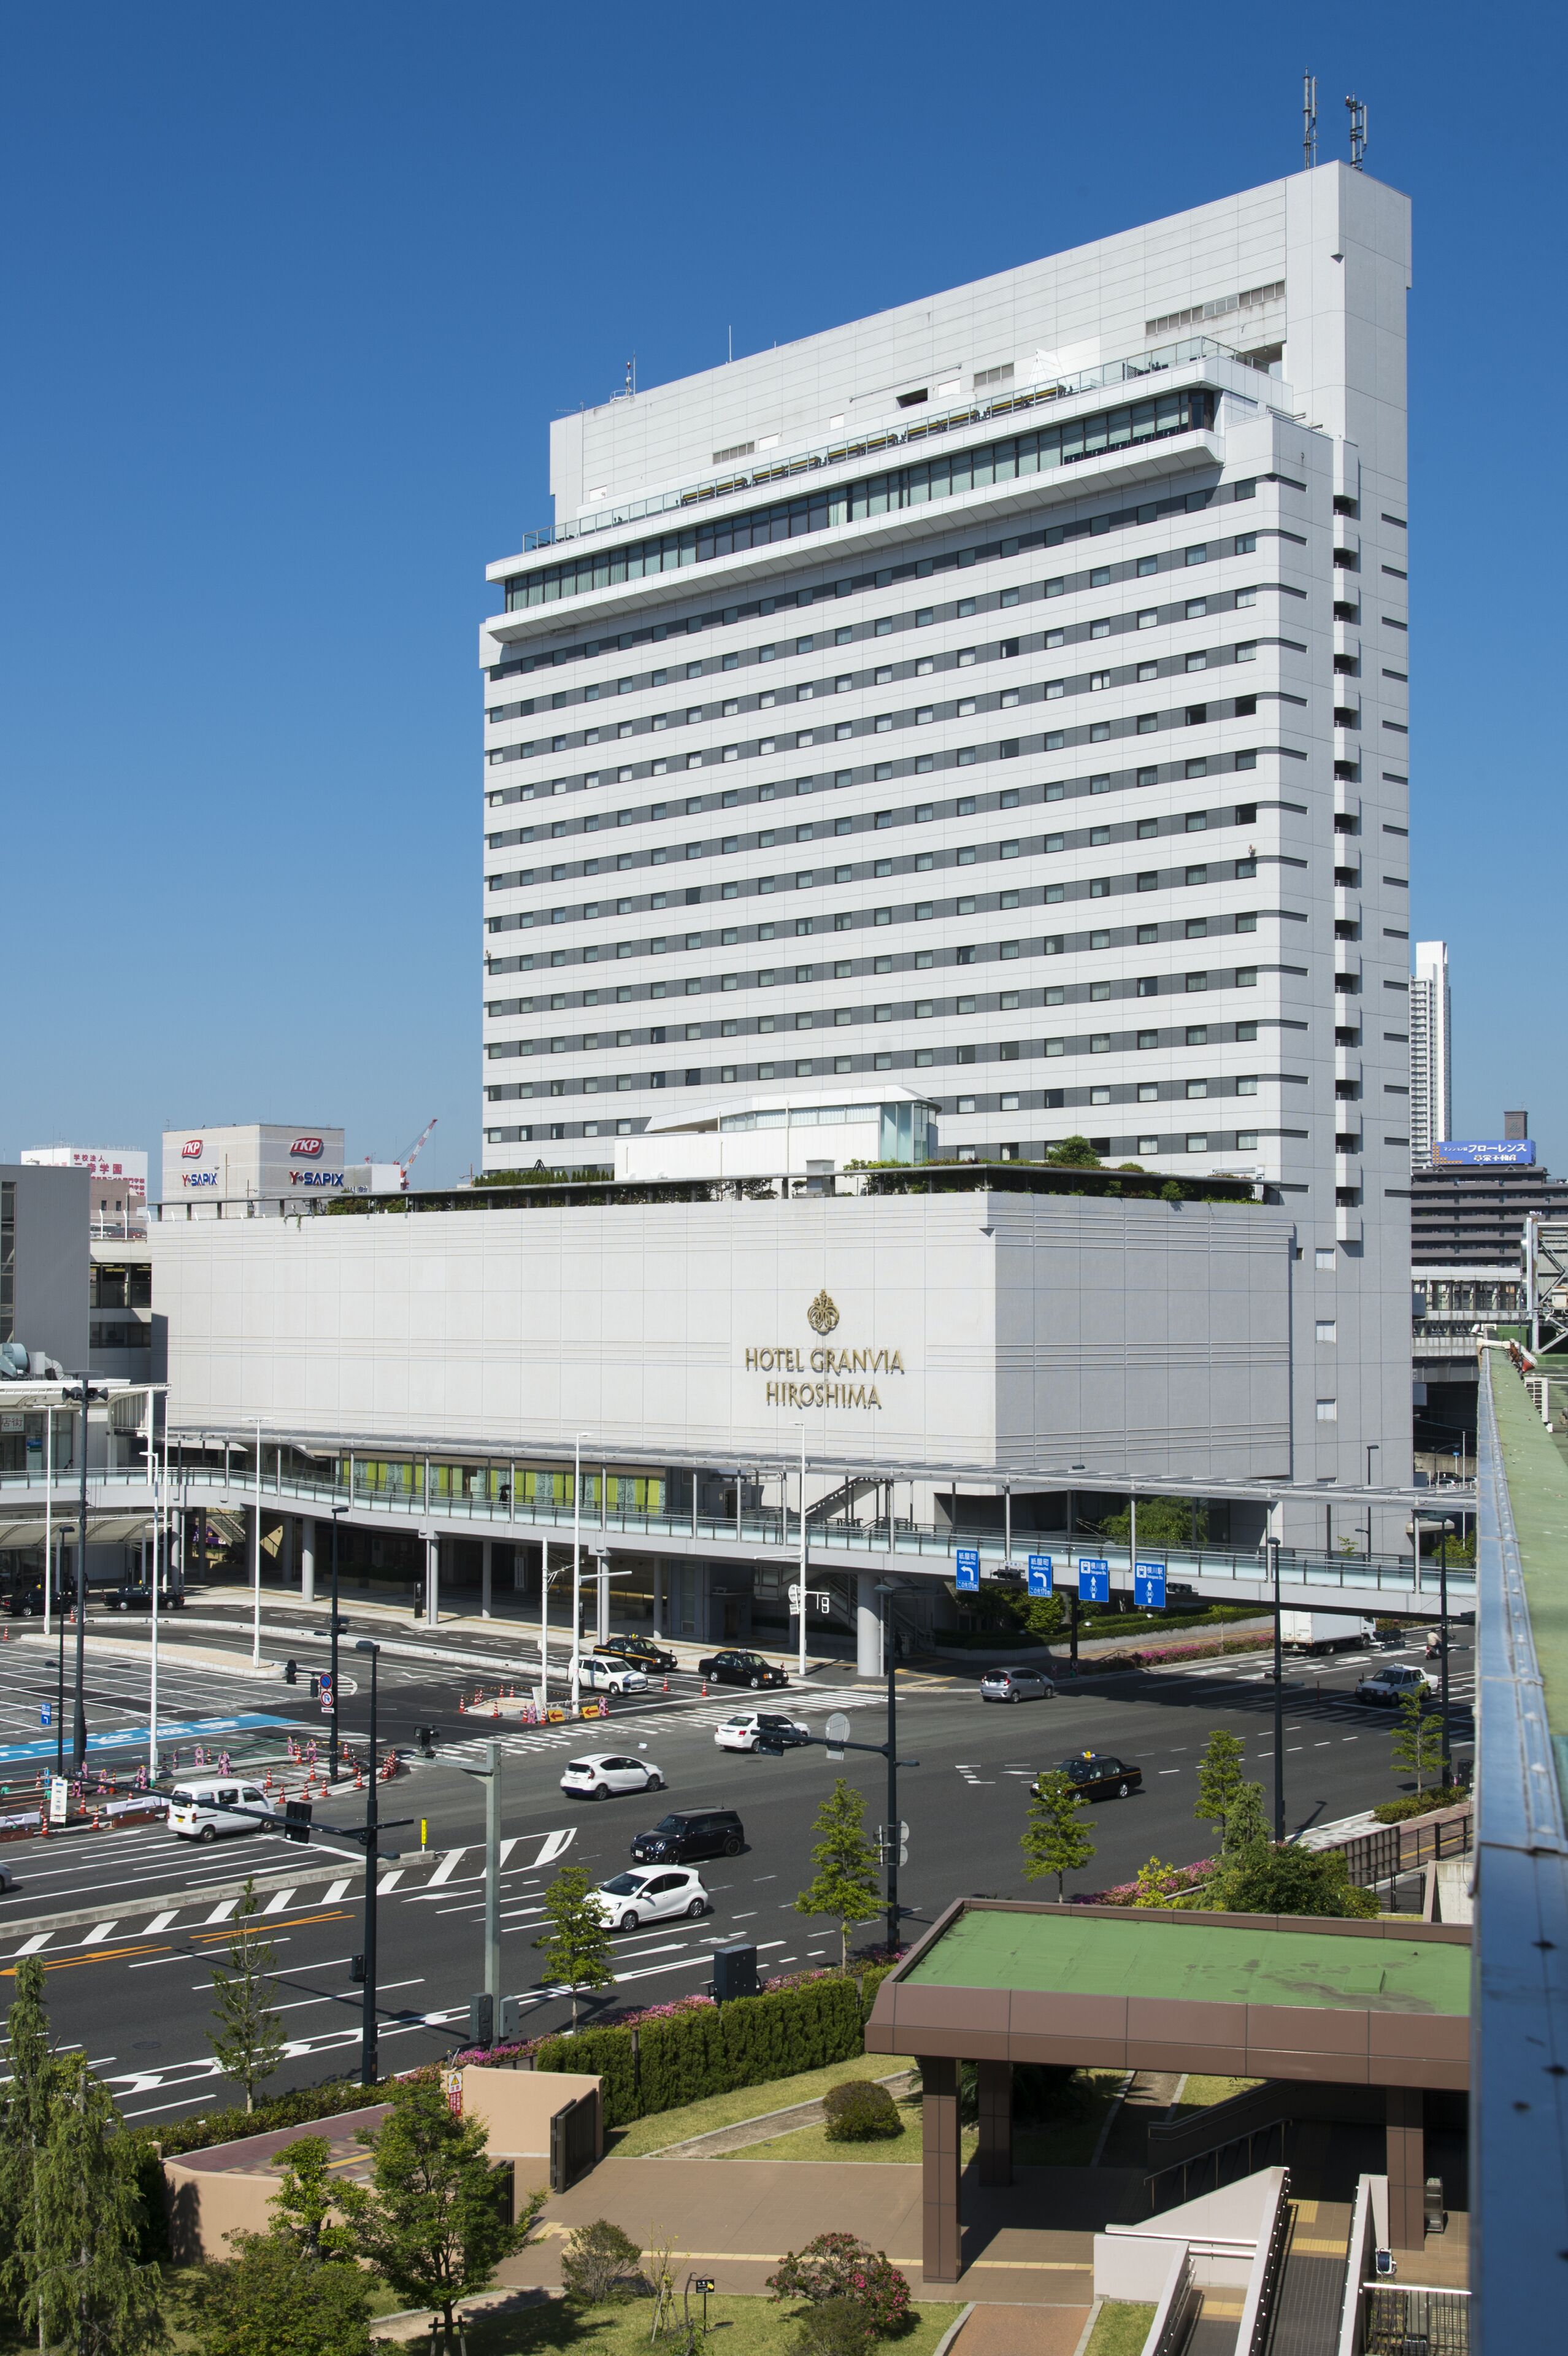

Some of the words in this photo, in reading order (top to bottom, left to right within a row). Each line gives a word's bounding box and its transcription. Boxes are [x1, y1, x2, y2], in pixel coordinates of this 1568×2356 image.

[183, 1142, 200, 1153] TKP
[293, 1140, 319, 1152] TKP
[1468, 1144, 1527, 1153] フローレンス
[74, 1153, 104, 1162] 学校法人
[745, 1347, 804, 1371] HOTEL
[809, 1348, 905, 1376] GRANVIA
[766, 1382, 882, 1409] HIROSHIMA
